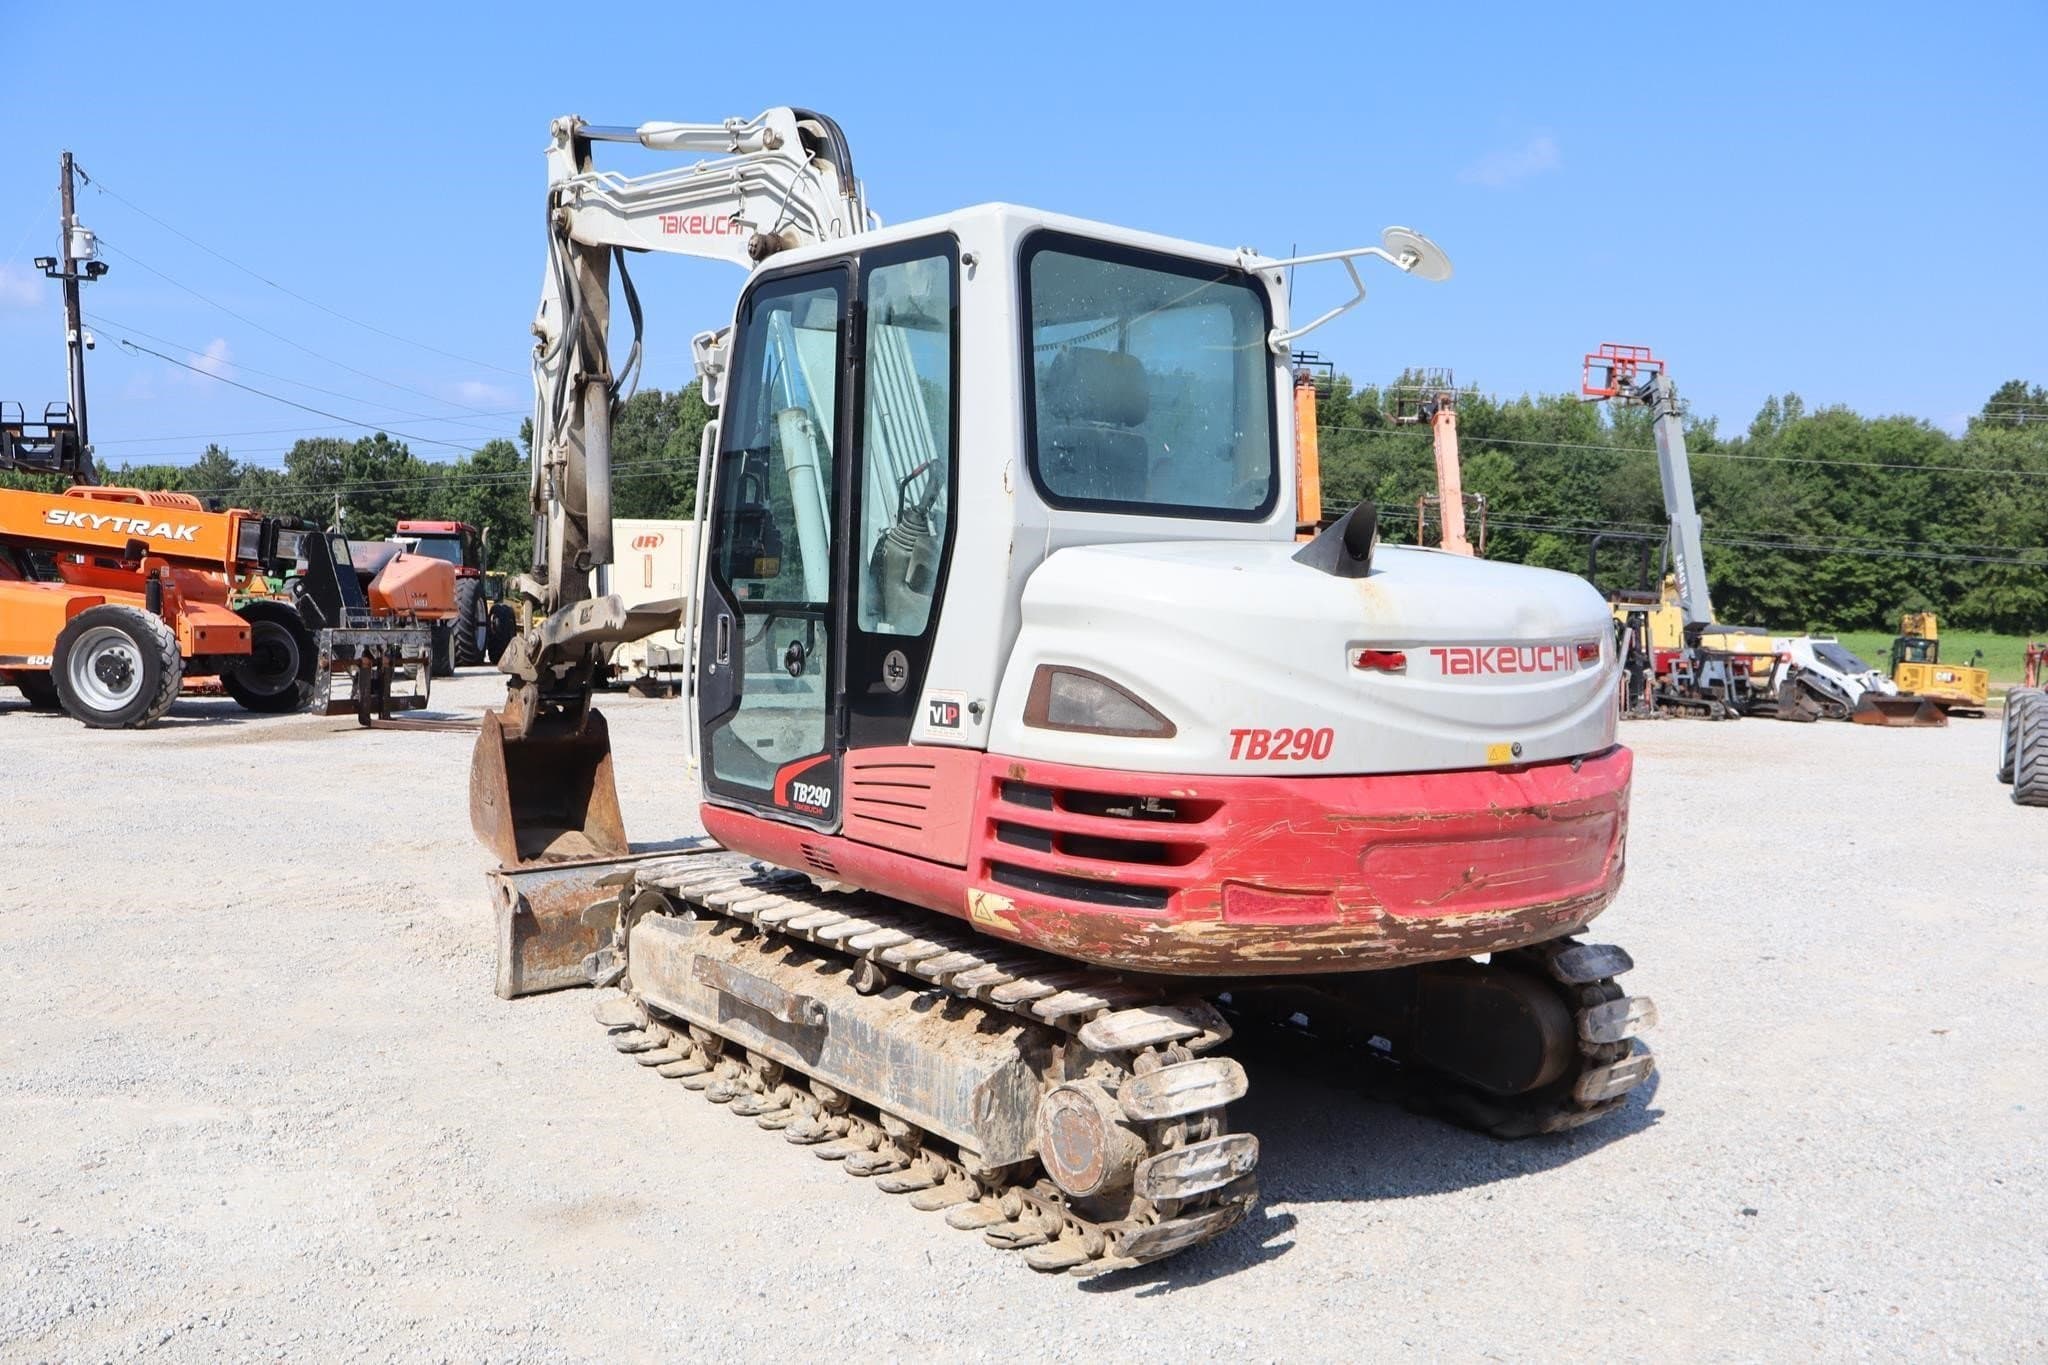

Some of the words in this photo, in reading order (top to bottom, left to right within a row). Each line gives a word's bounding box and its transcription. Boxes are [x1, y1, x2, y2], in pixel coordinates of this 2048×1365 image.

[46, 509, 202, 541] SKYTRAK
[636, 535, 658, 548] IR
[1429, 645, 1574, 675] TAKEUCHI
[1229, 727, 1334, 761] TB290
[793, 781, 831, 808] TB290
